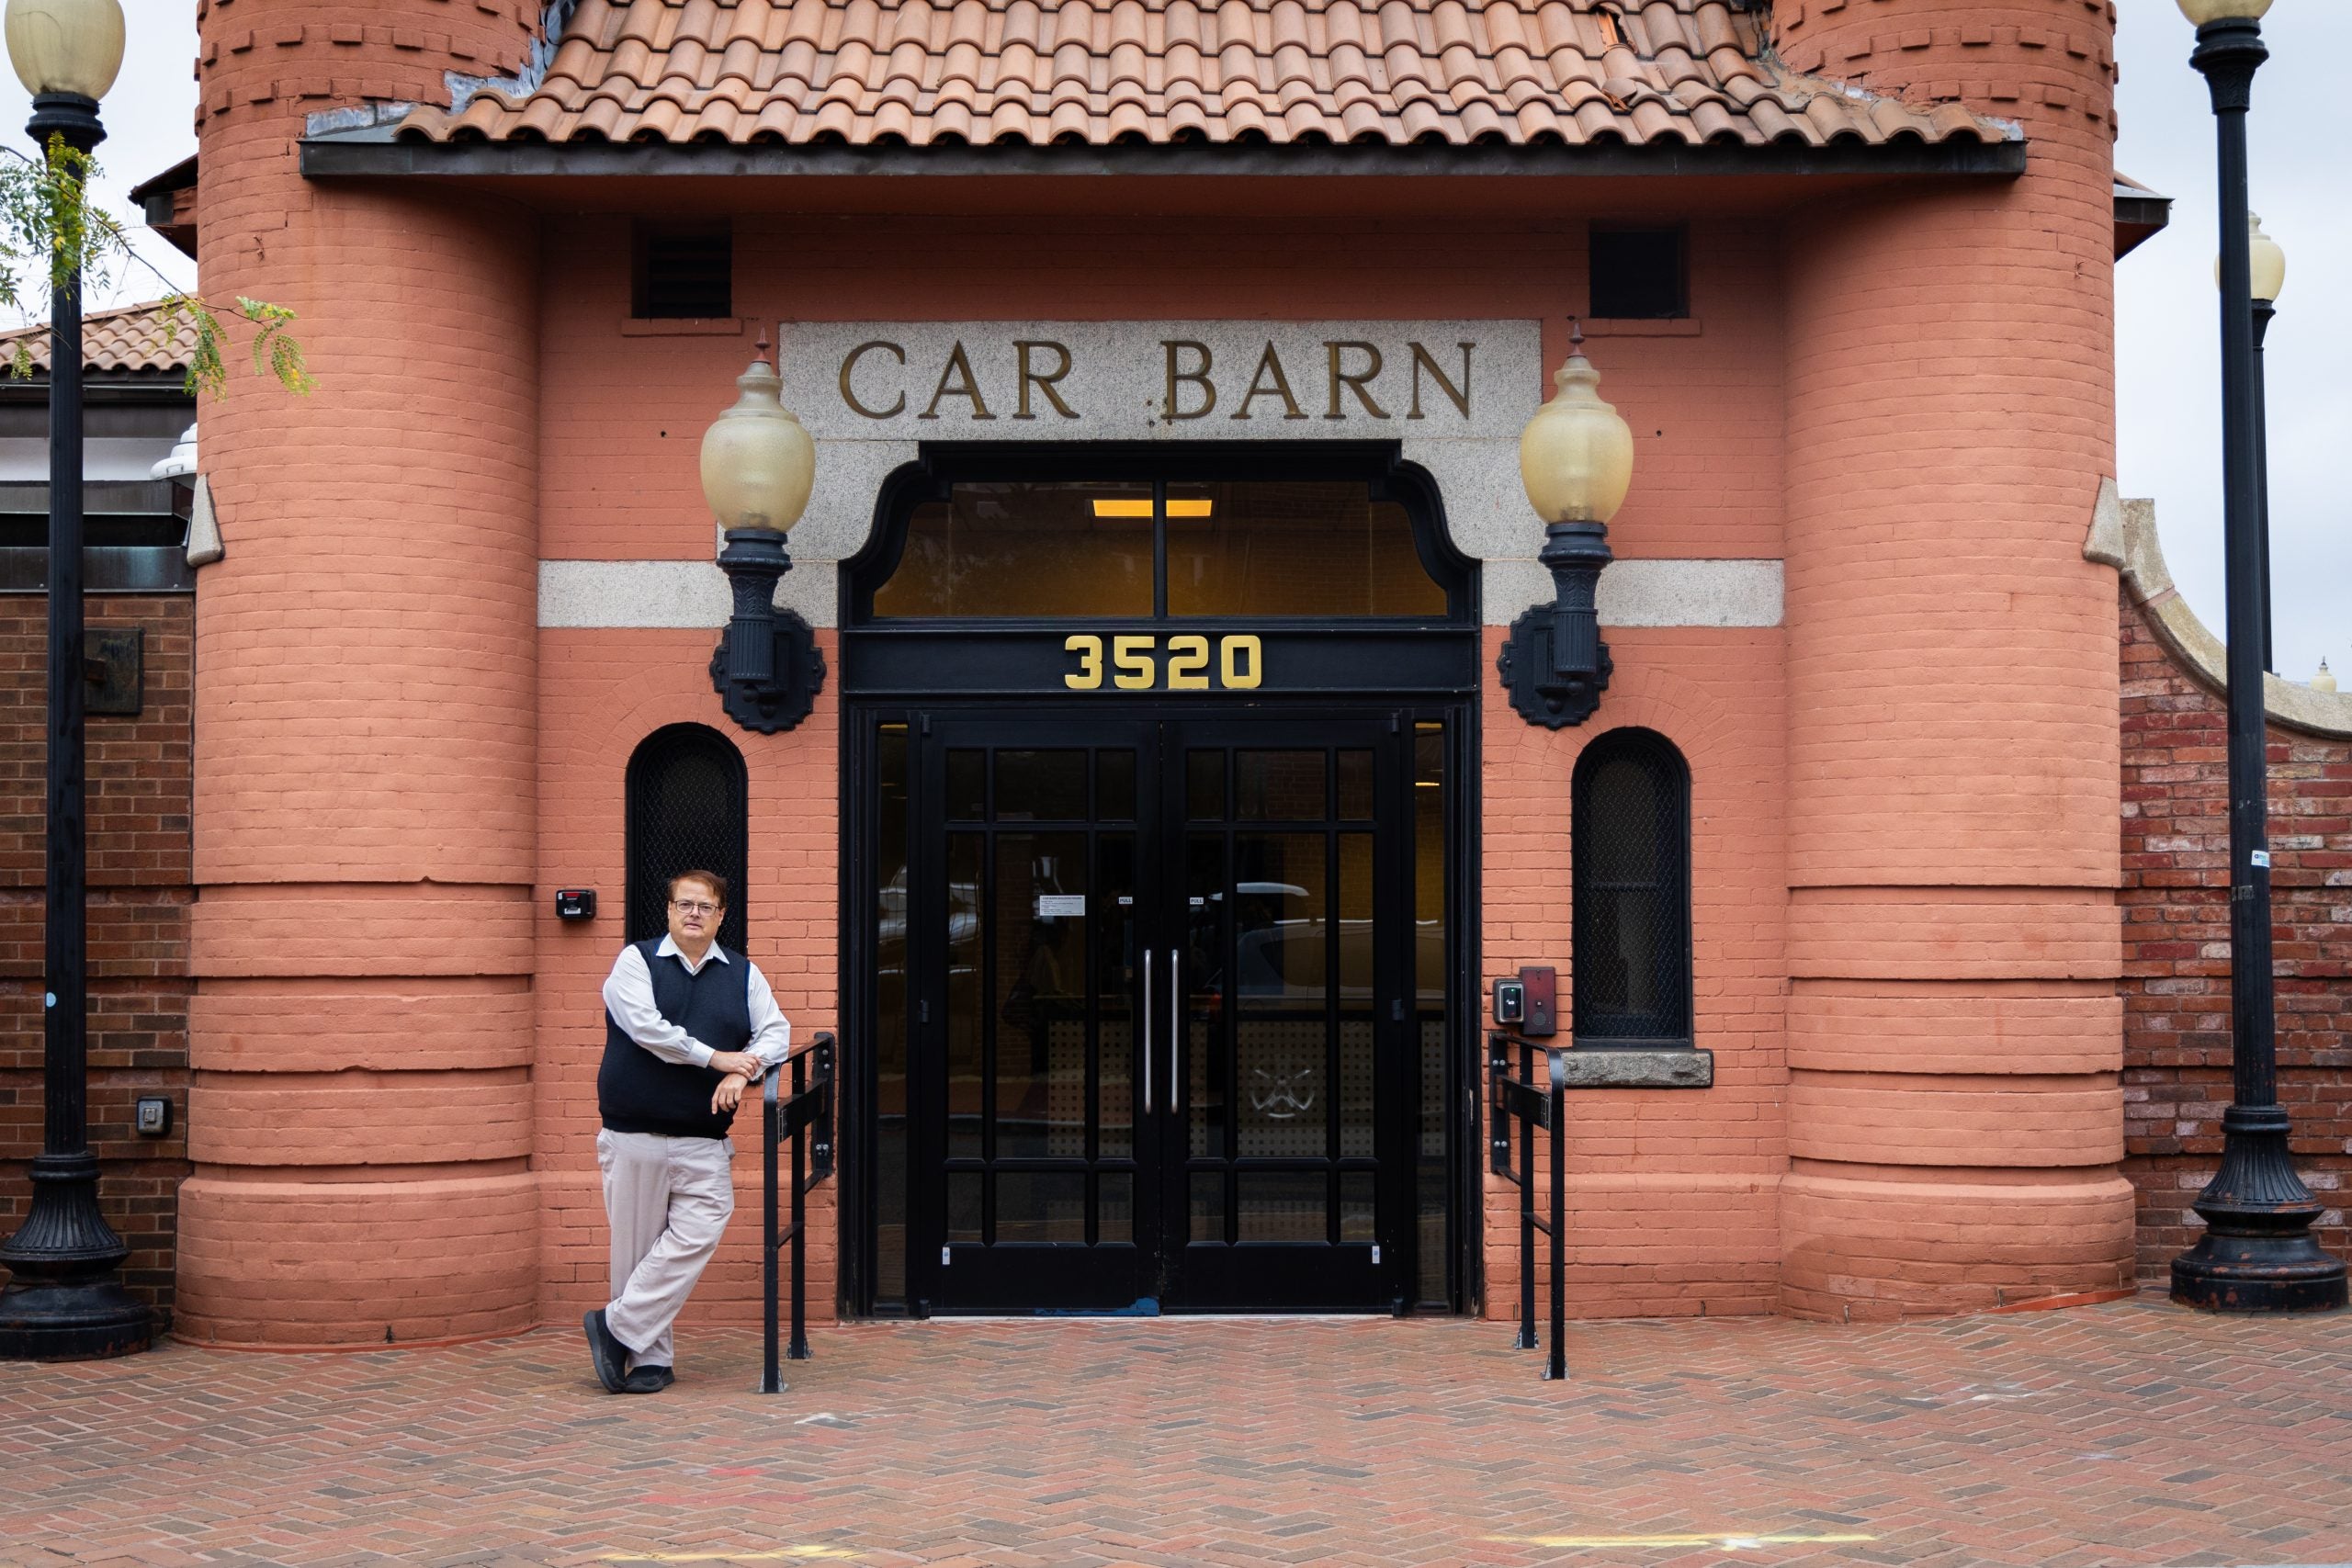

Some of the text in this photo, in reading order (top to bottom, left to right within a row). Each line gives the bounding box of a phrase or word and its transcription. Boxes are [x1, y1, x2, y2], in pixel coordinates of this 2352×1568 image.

[839, 339, 1476, 421] CAR BARN
[1064, 635, 1262, 690] 3520
